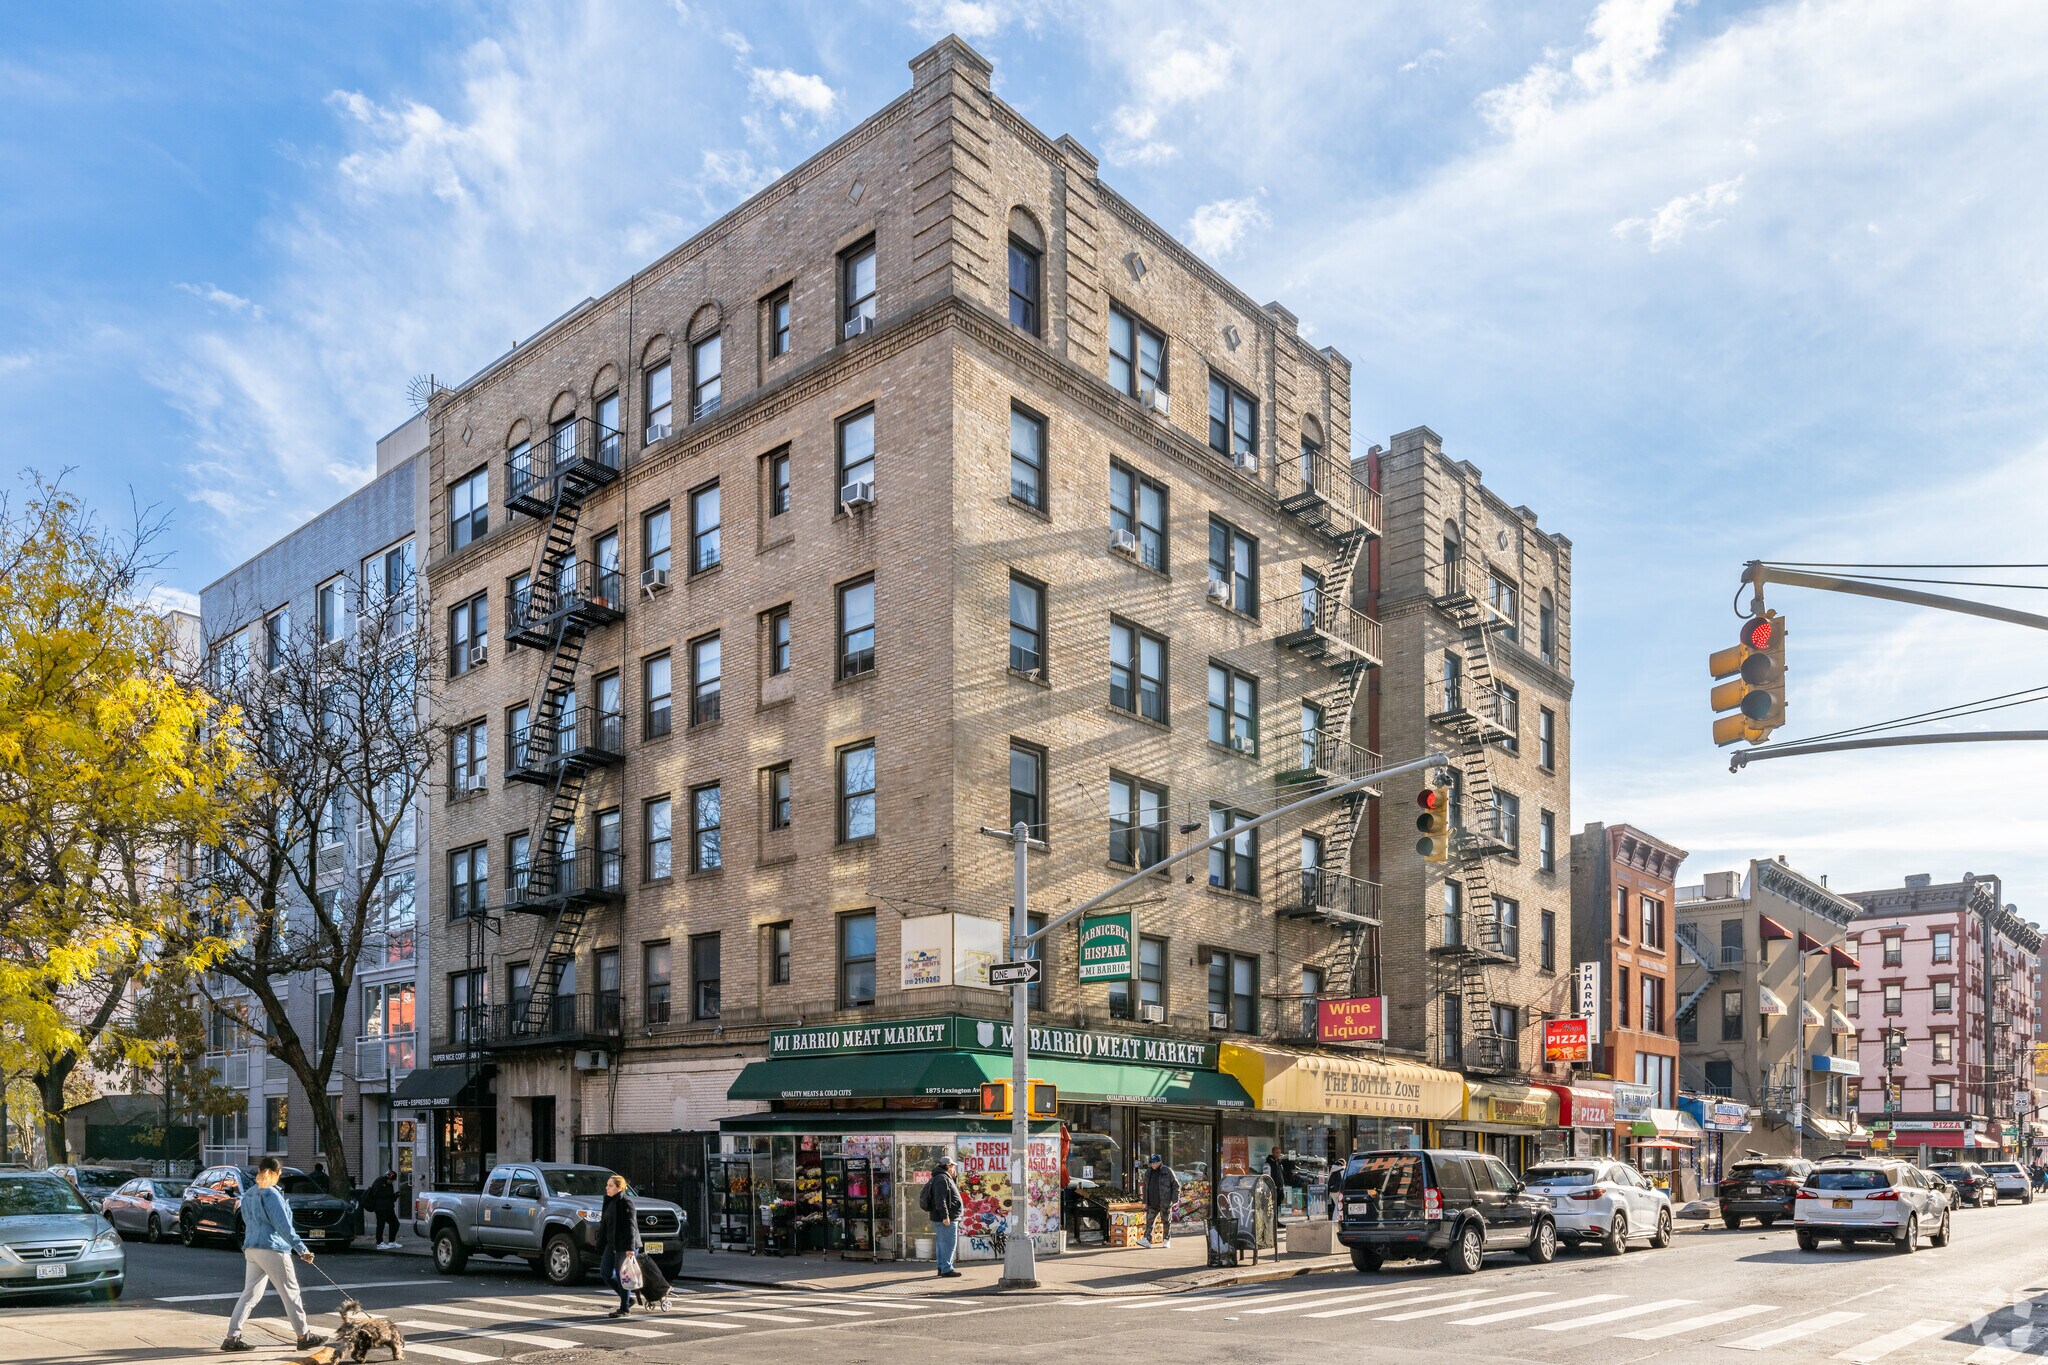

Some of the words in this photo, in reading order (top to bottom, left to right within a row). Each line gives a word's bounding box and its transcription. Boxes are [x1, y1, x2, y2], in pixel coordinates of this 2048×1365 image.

[1080, 924, 1130, 947] CARNICERIA
[1084, 944, 1127, 960] HISPANA
[994, 969, 1009, 980] ONE
[1016, 967, 1032, 977] WAY
[1085, 967, 1095, 976] MI
[1097, 963, 1126, 975] BARRIO
[1582, 964, 1594, 1017] PHARMA
[1329, 1002, 1371, 1015] Wine
[1344, 1016, 1355, 1025] &
[773, 1035, 789, 1052] MI
[792, 1031, 840, 1051] BARRIO
[842, 1029, 881, 1048] MEAT
[883, 1024, 945, 1045] MARKET
[1324, 1024, 1376, 1039] Liquor
[1001, 1025, 1014, 1048] M
[1029, 1028, 1093, 1055] BARRIO
[1095, 1035, 1141, 1060] MEAT
[1143, 1039, 1205, 1065] MARKET
[1547, 1034, 1587, 1045] PIZZA
[432, 1053, 445, 1062] SUPER
[445, 1053, 455, 1061] NICE
[941, 1087, 971, 1095] Lexington
[1324, 1074, 1347, 1092] THE
[1351, 1076, 1392, 1096] BOTTLE
[1395, 1080, 1420, 1098] ZONE
[781, 1090, 802, 1098] QUALITY
[1106, 1094, 1125, 1102] QUALITY
[1266, 1099, 1278, 1107] 1875
[1324, 1098, 1357, 1110] WINE
[1363, 1100, 1369, 1110] &
[1375, 1101, 1419, 1114] LIQUOR
[1581, 1107, 1605, 1122] PIZZA
[1932, 1121, 1961, 1129] PIZZA
[1222, 1137, 1245, 1145] MERICA'S
[976, 1142, 1010, 1157] FRESH
[1027, 1142, 1046, 1157] WER
[963, 1157, 985, 1171] FOR
[988, 1157, 1008, 1171] ALL
